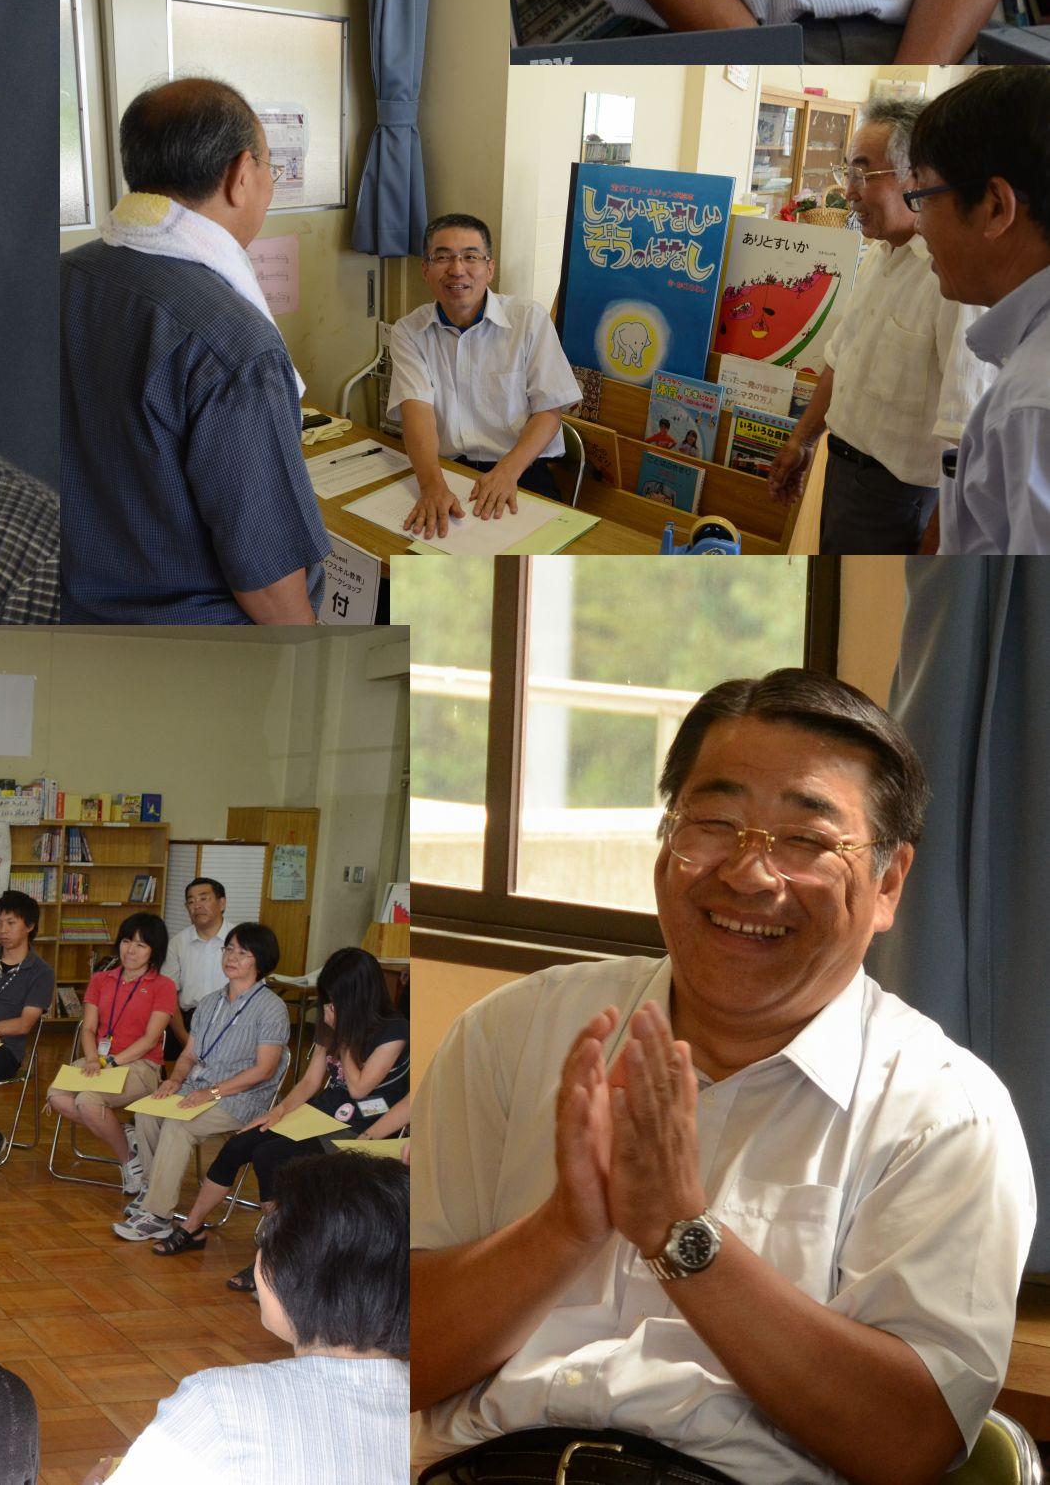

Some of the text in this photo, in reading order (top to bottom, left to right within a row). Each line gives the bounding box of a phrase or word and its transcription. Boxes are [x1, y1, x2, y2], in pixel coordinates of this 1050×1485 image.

[582, 185, 723, 237] しろいやさしい
[583, 223, 716, 282] ぞうのはなし
[742, 232, 810, 254] ありとすいか
[327, 572, 363, 594] ワークショップ
[332, 591, 350, 618] 付
